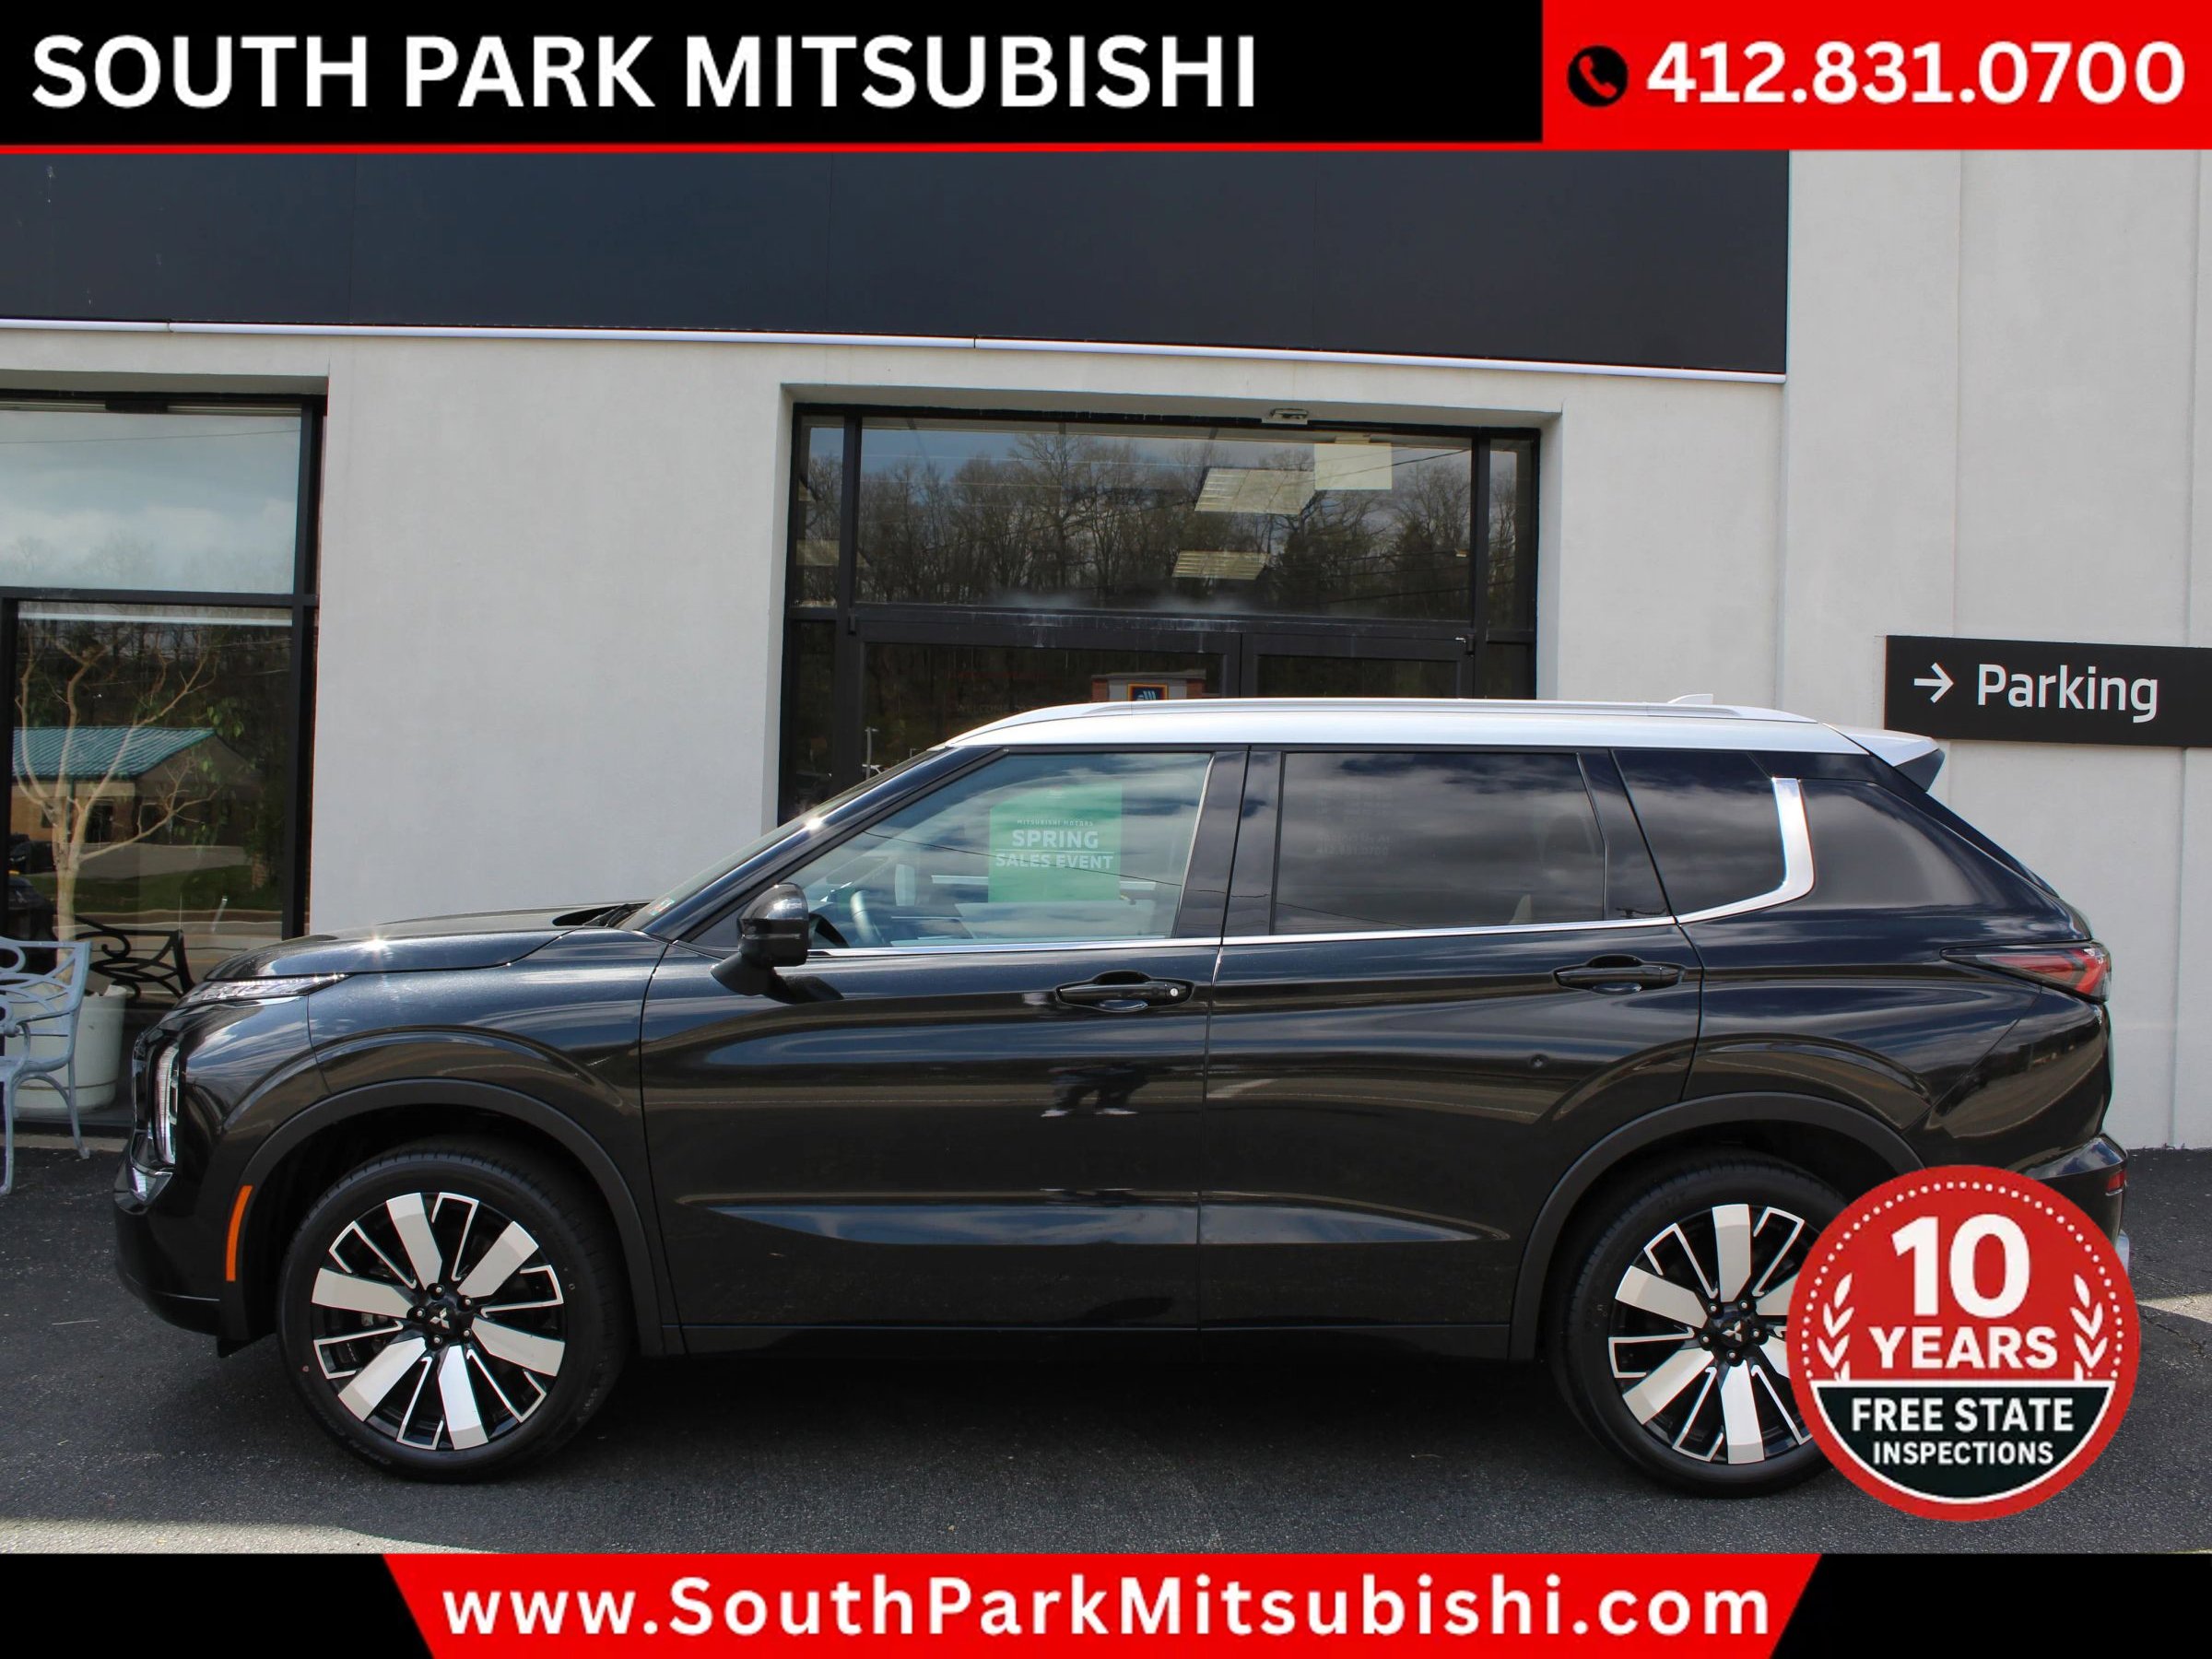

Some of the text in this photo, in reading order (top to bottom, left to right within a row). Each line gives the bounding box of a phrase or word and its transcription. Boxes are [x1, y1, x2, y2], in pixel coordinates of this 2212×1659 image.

[1978, 664, 2159, 724] Parking
[1012, 829, 1099, 848] SPRING
[995, 853, 1113, 869] SALES EVENT
